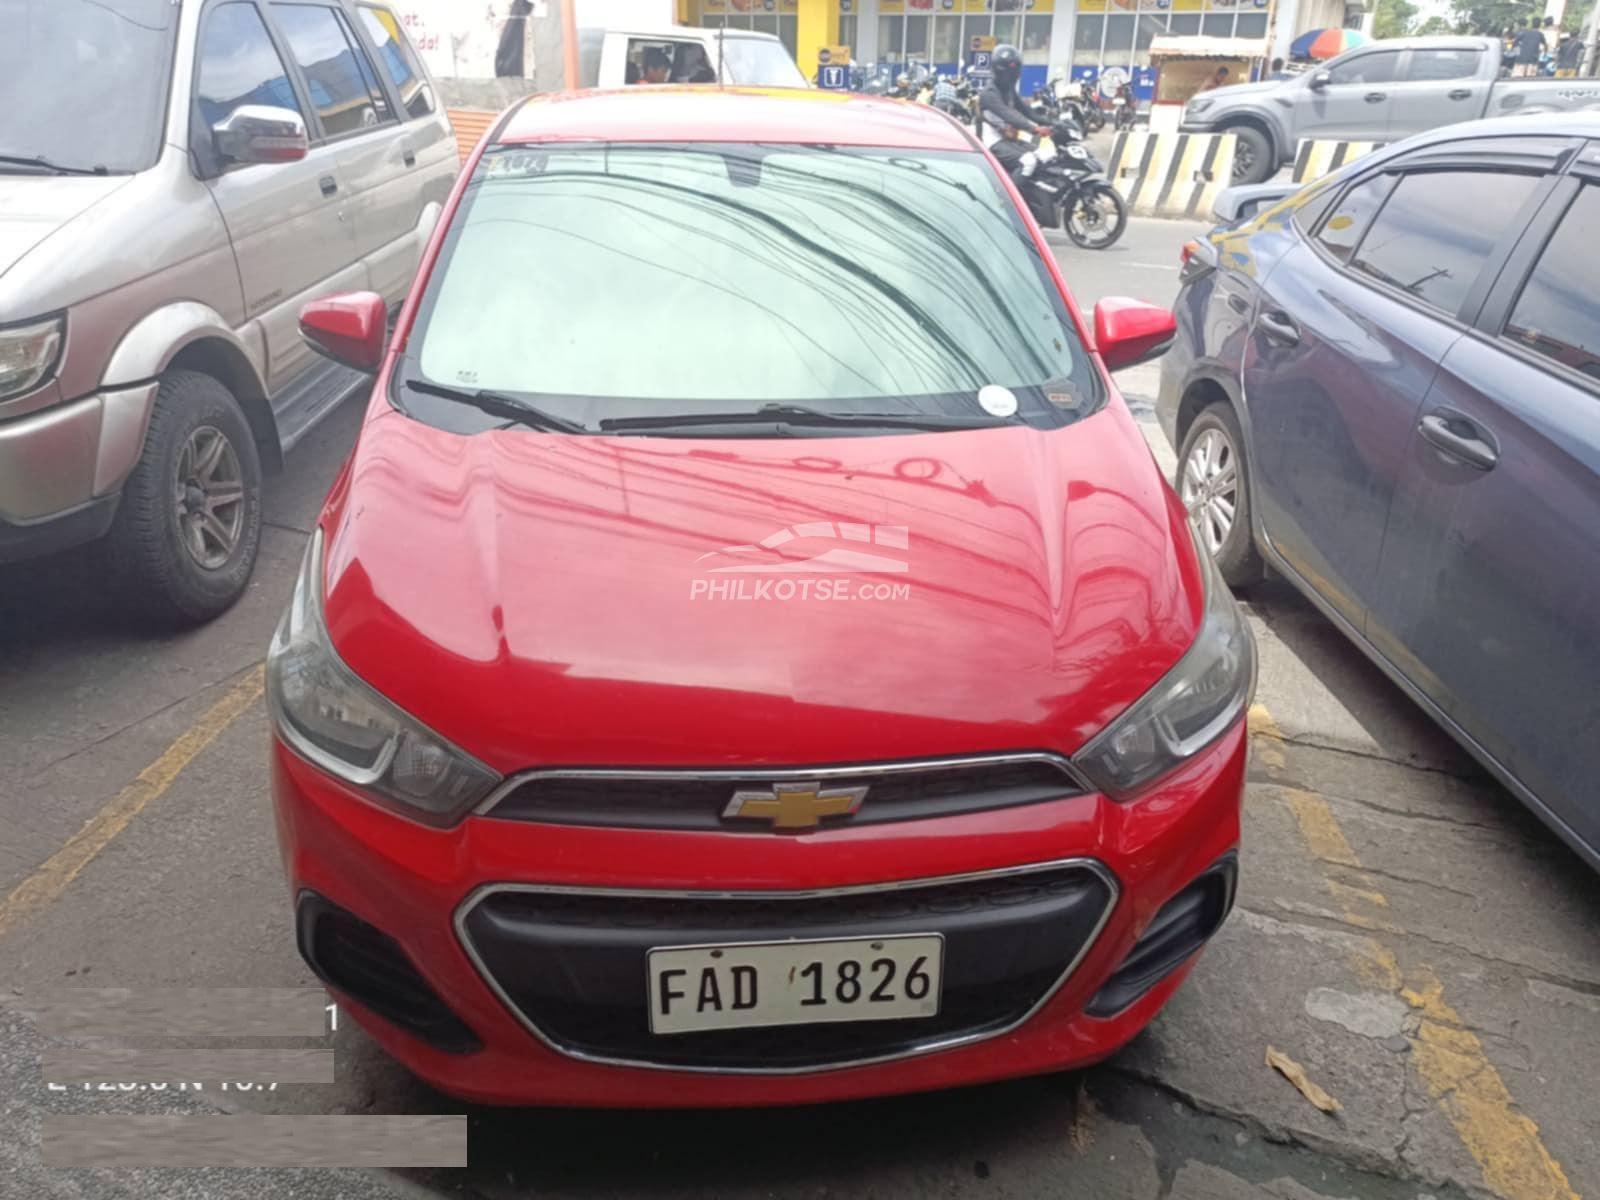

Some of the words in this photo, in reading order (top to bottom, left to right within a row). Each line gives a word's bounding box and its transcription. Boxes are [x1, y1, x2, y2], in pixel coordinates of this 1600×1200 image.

[403, 12, 425, 27] at.
[416, 32, 439, 51] da!
[659, 965, 758, 1015] FAD
[800, 956, 931, 1006] 1826
